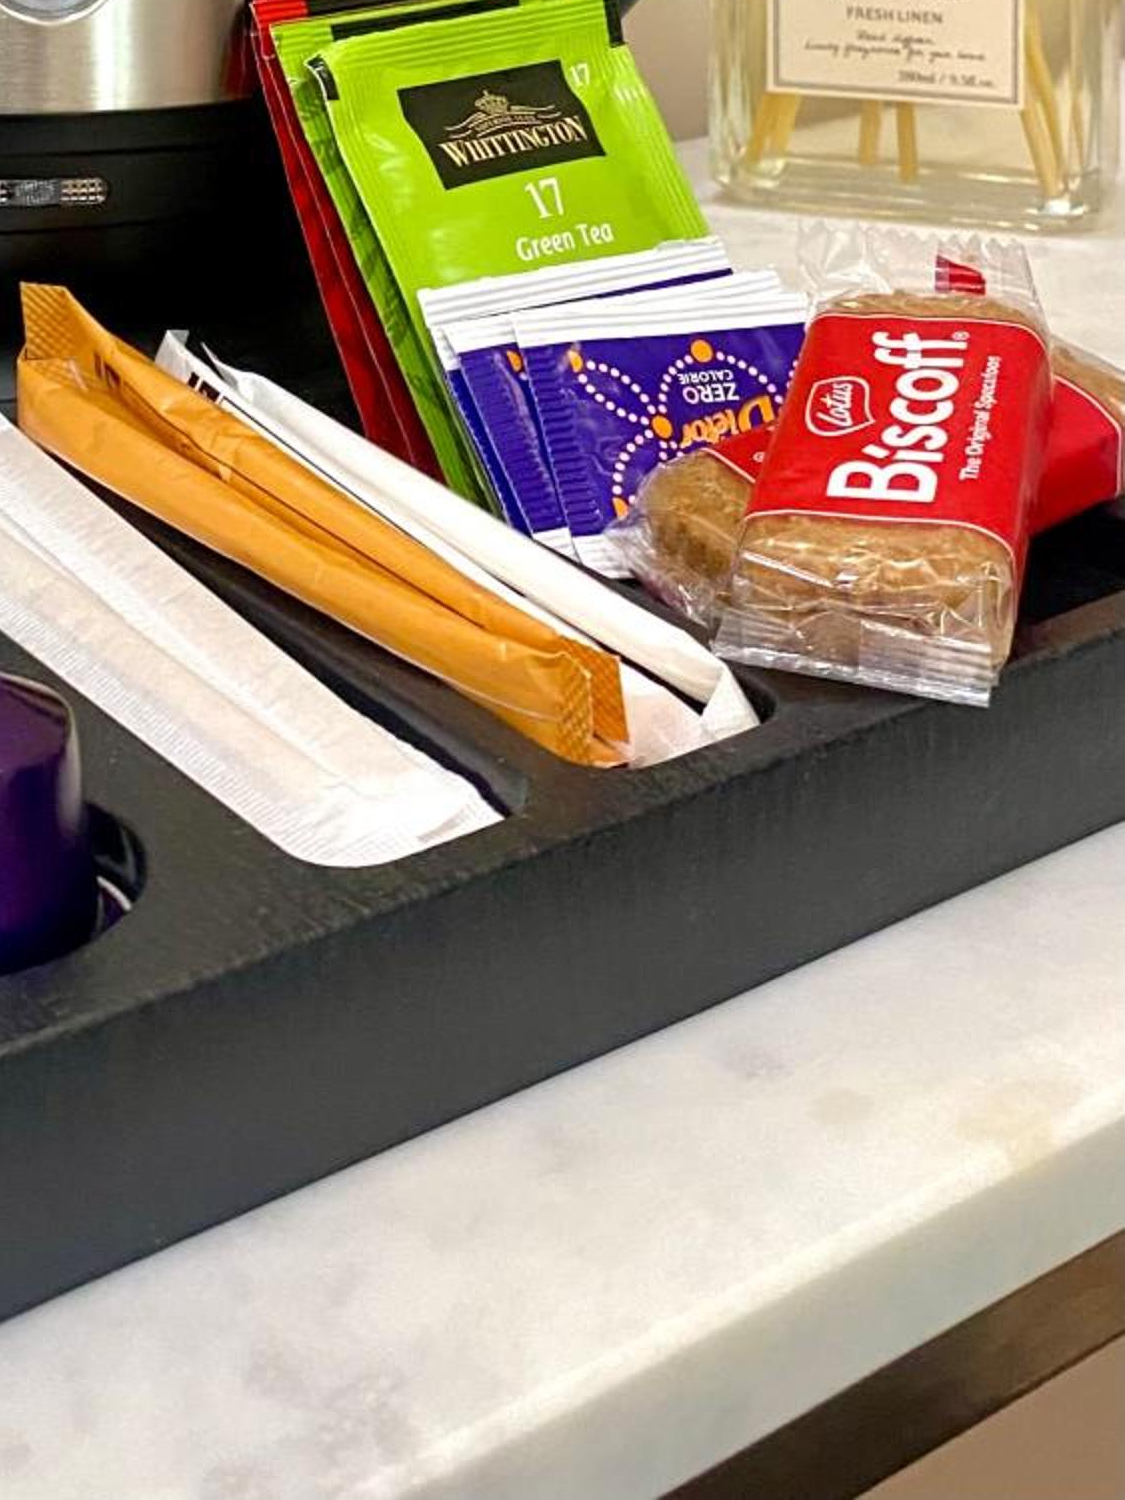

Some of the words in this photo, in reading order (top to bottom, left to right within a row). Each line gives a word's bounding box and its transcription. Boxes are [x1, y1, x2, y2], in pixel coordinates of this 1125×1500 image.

[897, 9, 944, 25] LINEN
[571, 63, 590, 88] 17
[438, 116, 588, 168] WHITTINGTON
[525, 177, 564, 220] 17
[516, 230, 575, 262] Green
[578, 222, 615, 246] Tea
[678, 369, 735, 385] CALORIE
[682, 382, 741, 405] ZERO
[815, 382, 853, 428] Lotus
[825, 330, 968, 503] Biscoff
[965, 409, 993, 456] Original
[958, 456, 982, 482] The
